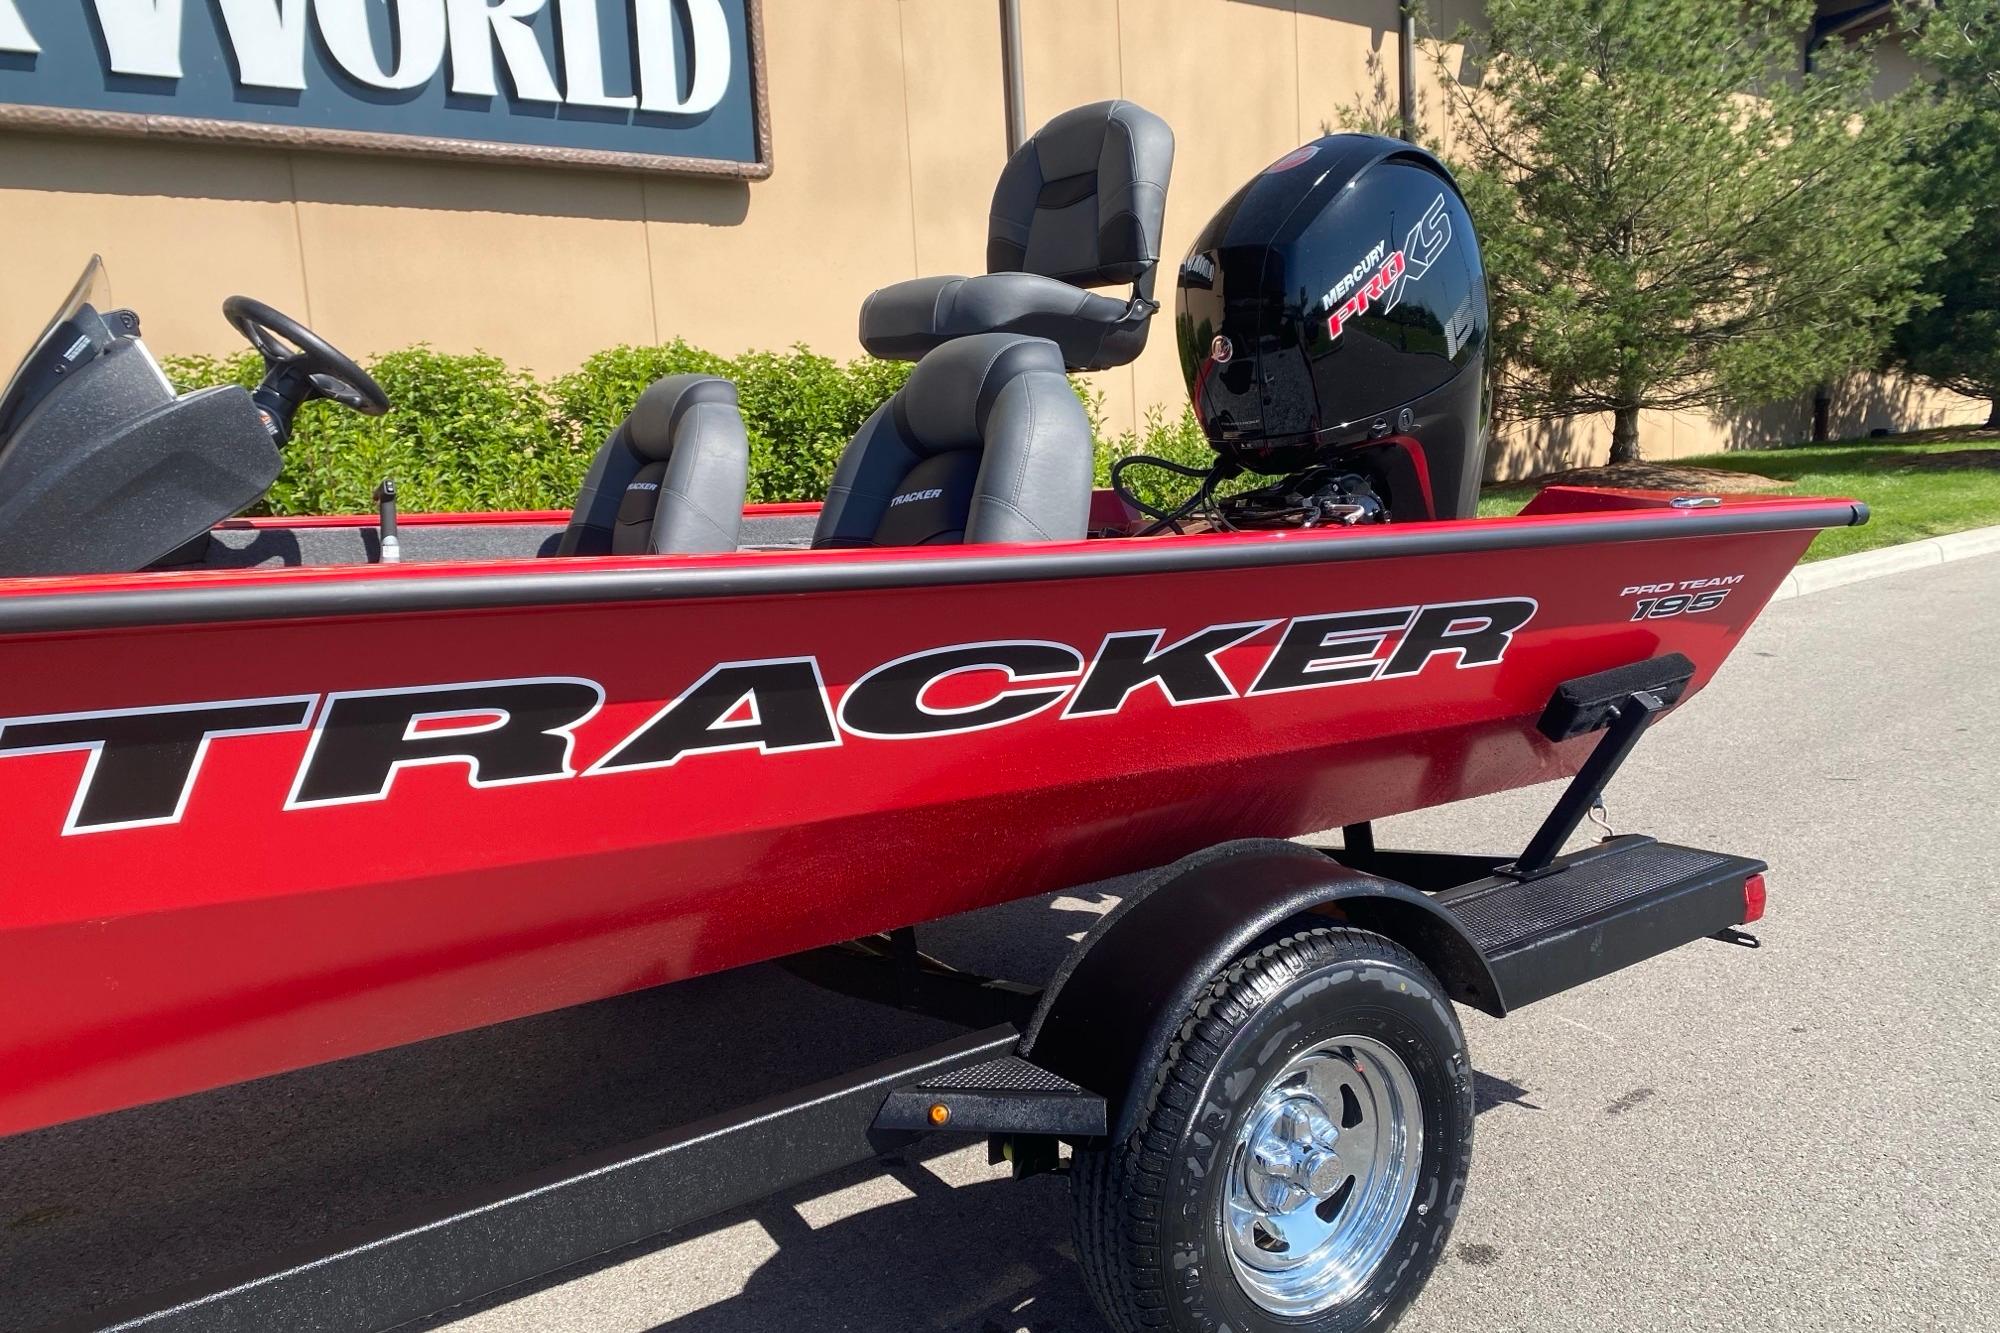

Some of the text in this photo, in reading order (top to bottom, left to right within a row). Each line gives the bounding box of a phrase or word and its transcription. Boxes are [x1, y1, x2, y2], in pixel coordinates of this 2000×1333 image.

[1322, 240, 1385, 311] MERCURY
[890, 488, 943, 508] TRACKER
[1620, 574, 1744, 597] PRO TEAM
[1630, 588, 1731, 622] 195
[0, 595, 1539, 836] TRACKER
